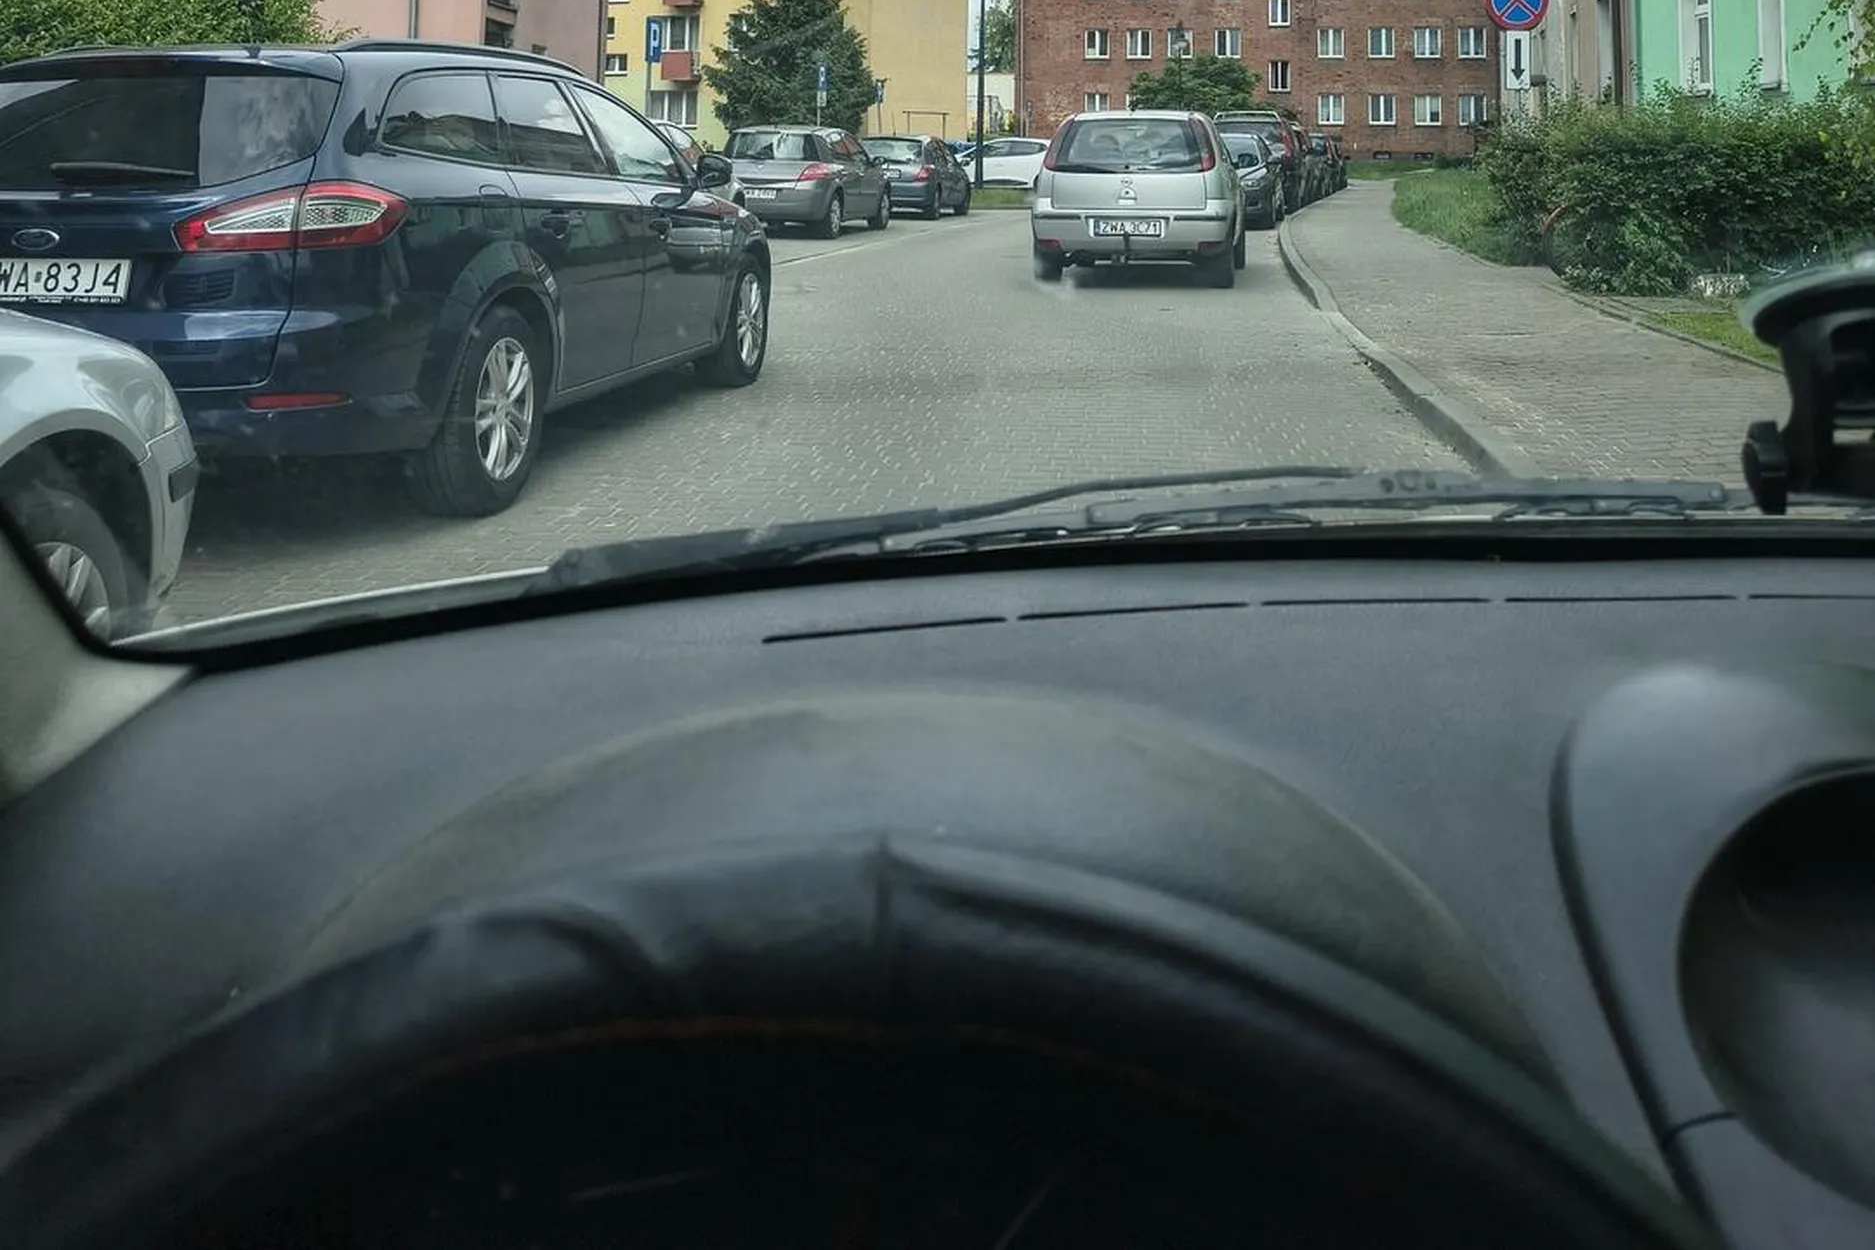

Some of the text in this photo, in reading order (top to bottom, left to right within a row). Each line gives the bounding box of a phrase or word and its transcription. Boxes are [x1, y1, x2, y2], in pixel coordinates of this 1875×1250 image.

[650, 21, 660, 56] P
[1102, 221, 1126, 233] ZWA
[43, 262, 122, 294] 83J4
